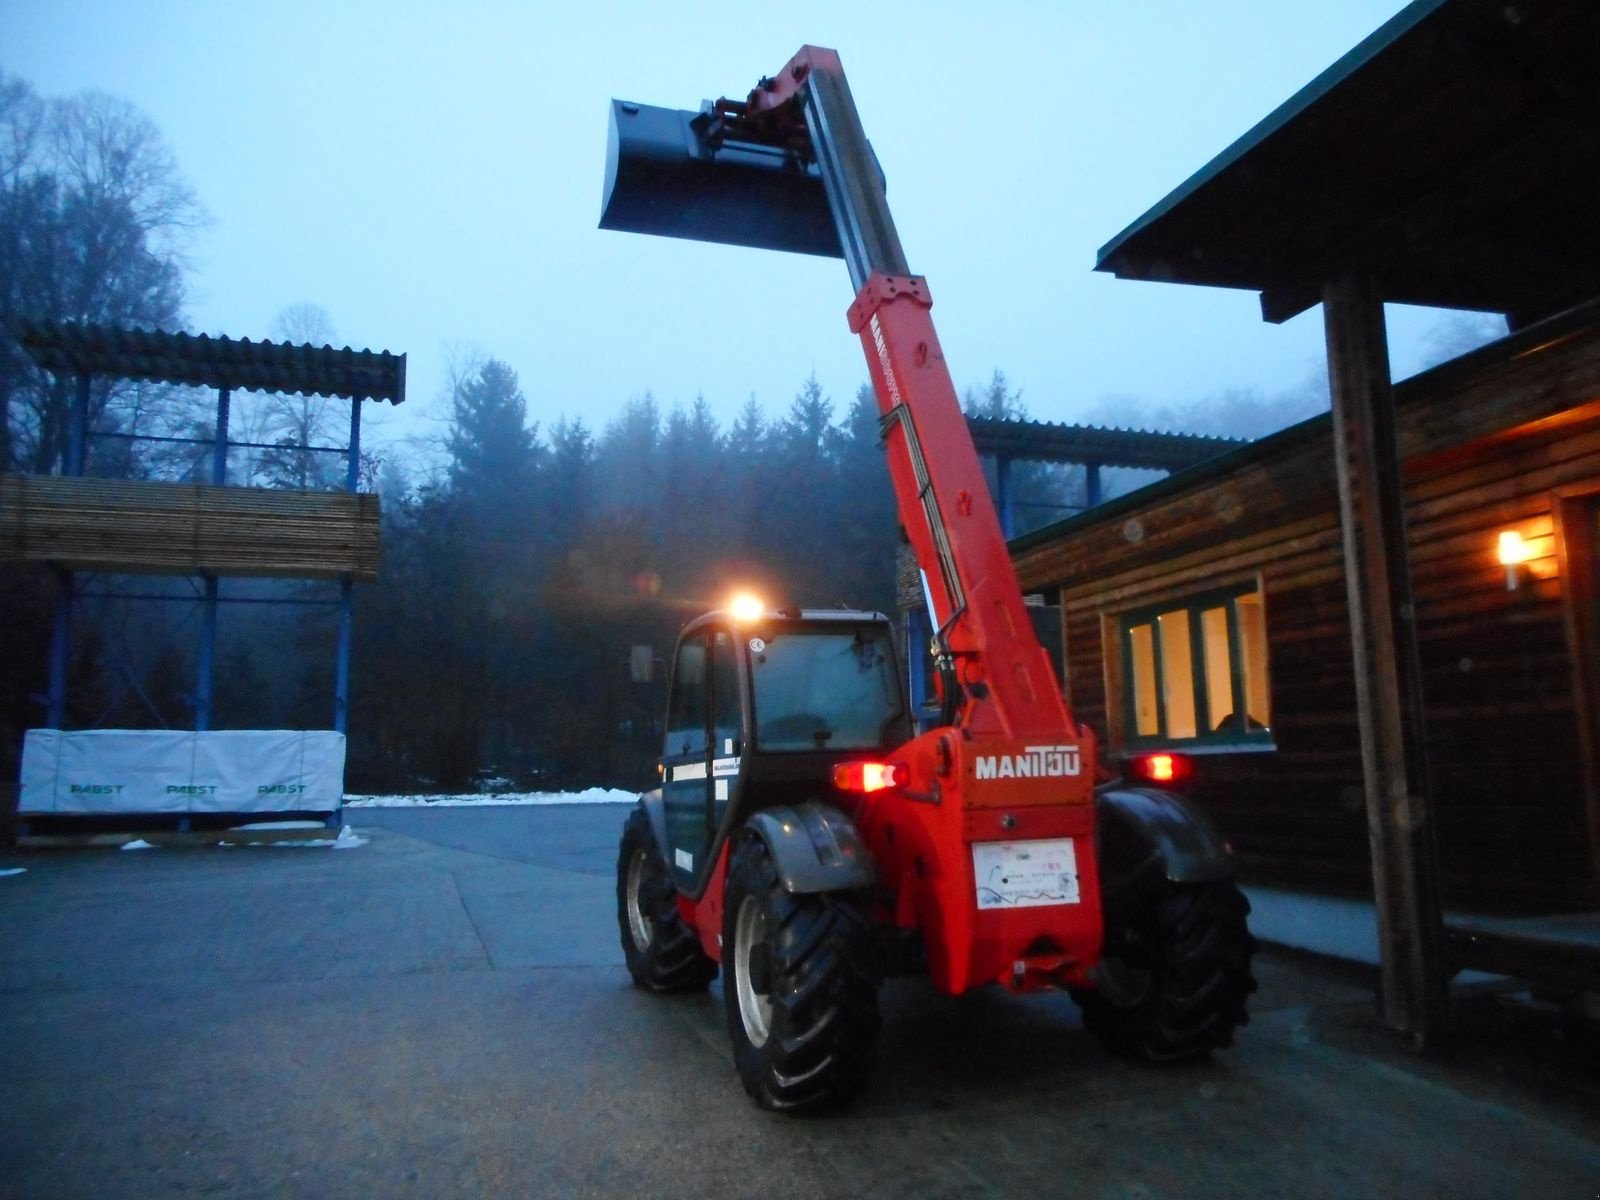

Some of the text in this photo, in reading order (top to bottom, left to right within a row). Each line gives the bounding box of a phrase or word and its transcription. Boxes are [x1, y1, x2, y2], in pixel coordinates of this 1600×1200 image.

[975, 745, 1080, 779] MANITOU
[70, 784, 125, 795] PABST
[166, 784, 219, 795] PABST
[257, 783, 307, 795] PABST
